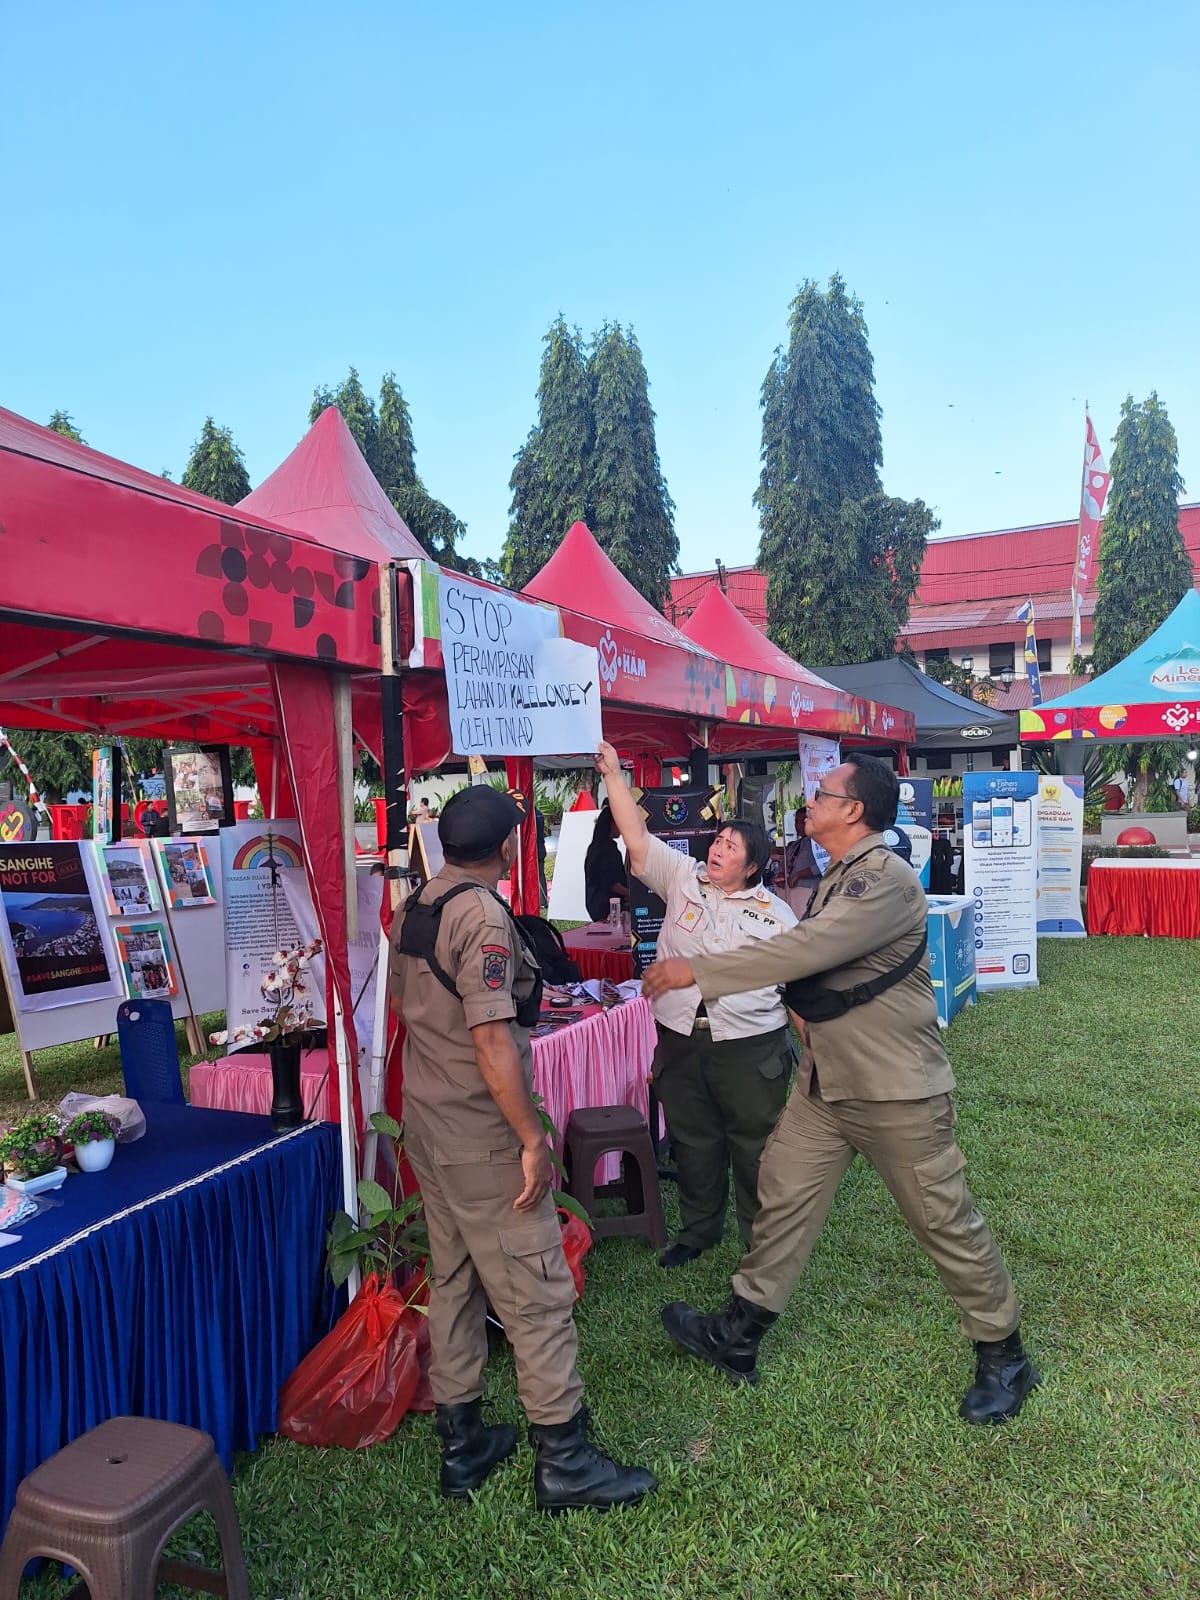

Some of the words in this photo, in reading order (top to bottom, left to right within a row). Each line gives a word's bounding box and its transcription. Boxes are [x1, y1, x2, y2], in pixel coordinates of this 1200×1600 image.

[446, 587, 512, 646] STOP
[451, 642, 535, 679] PERAMPASAN
[622, 654, 647, 677] HAM
[1152, 674, 1200, 683] Mine
[455, 678, 494, 709] LAHAN
[498, 682, 507, 707] DI
[510, 681, 593, 709] KALELONDEY
[459, 717, 493, 750] OLEH
[0, 857, 54, 871] SANGIHE
[2, 873, 29, 885] NOT
[31, 871, 57, 883] FOR
[743, 909, 760, 921] POL
[763, 917, 776, 926] PP
[241, 1007, 260, 1015] Save
